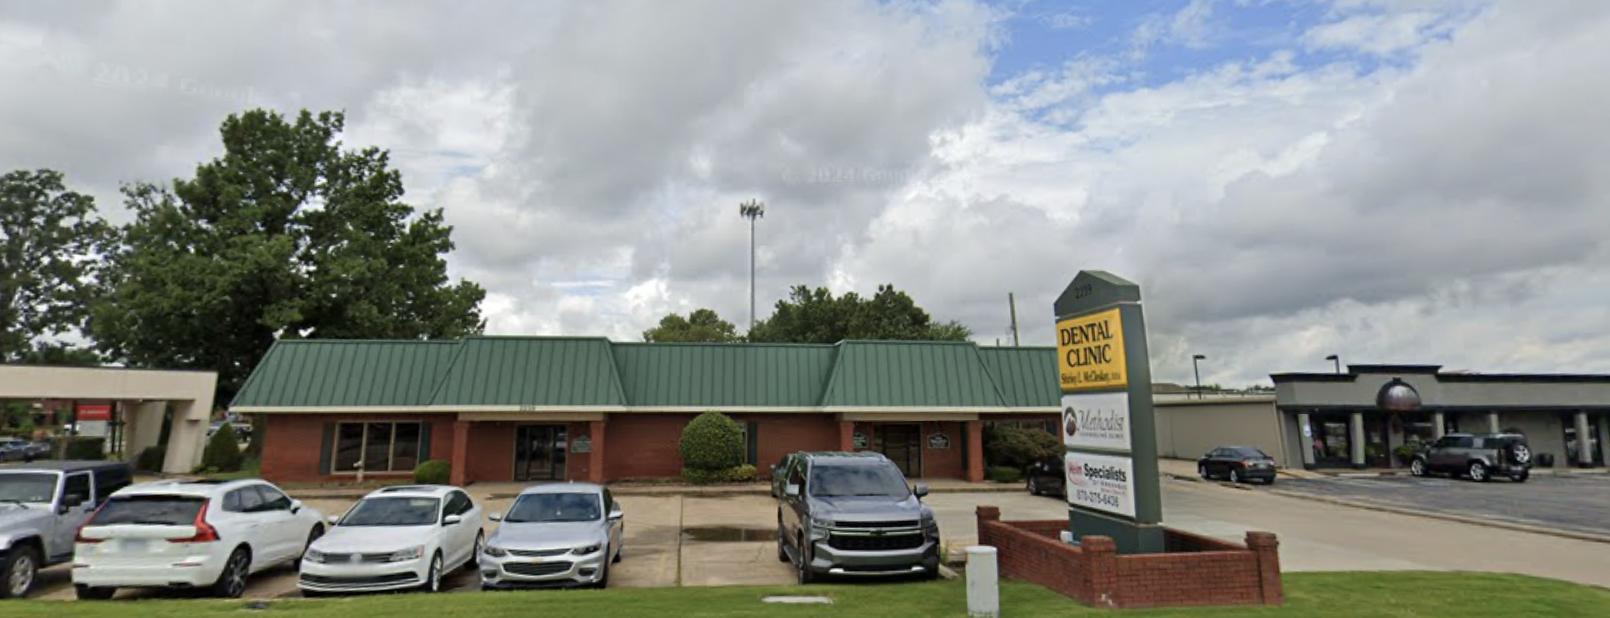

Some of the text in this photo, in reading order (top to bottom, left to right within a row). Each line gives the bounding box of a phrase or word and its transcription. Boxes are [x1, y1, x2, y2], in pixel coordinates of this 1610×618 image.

[1061, 320, 1113, 346] DENTAL
[1066, 343, 1112, 368] CLINIC
[1077, 409, 1124, 431] Methodist
[1084, 463, 1127, 482] Specialists
